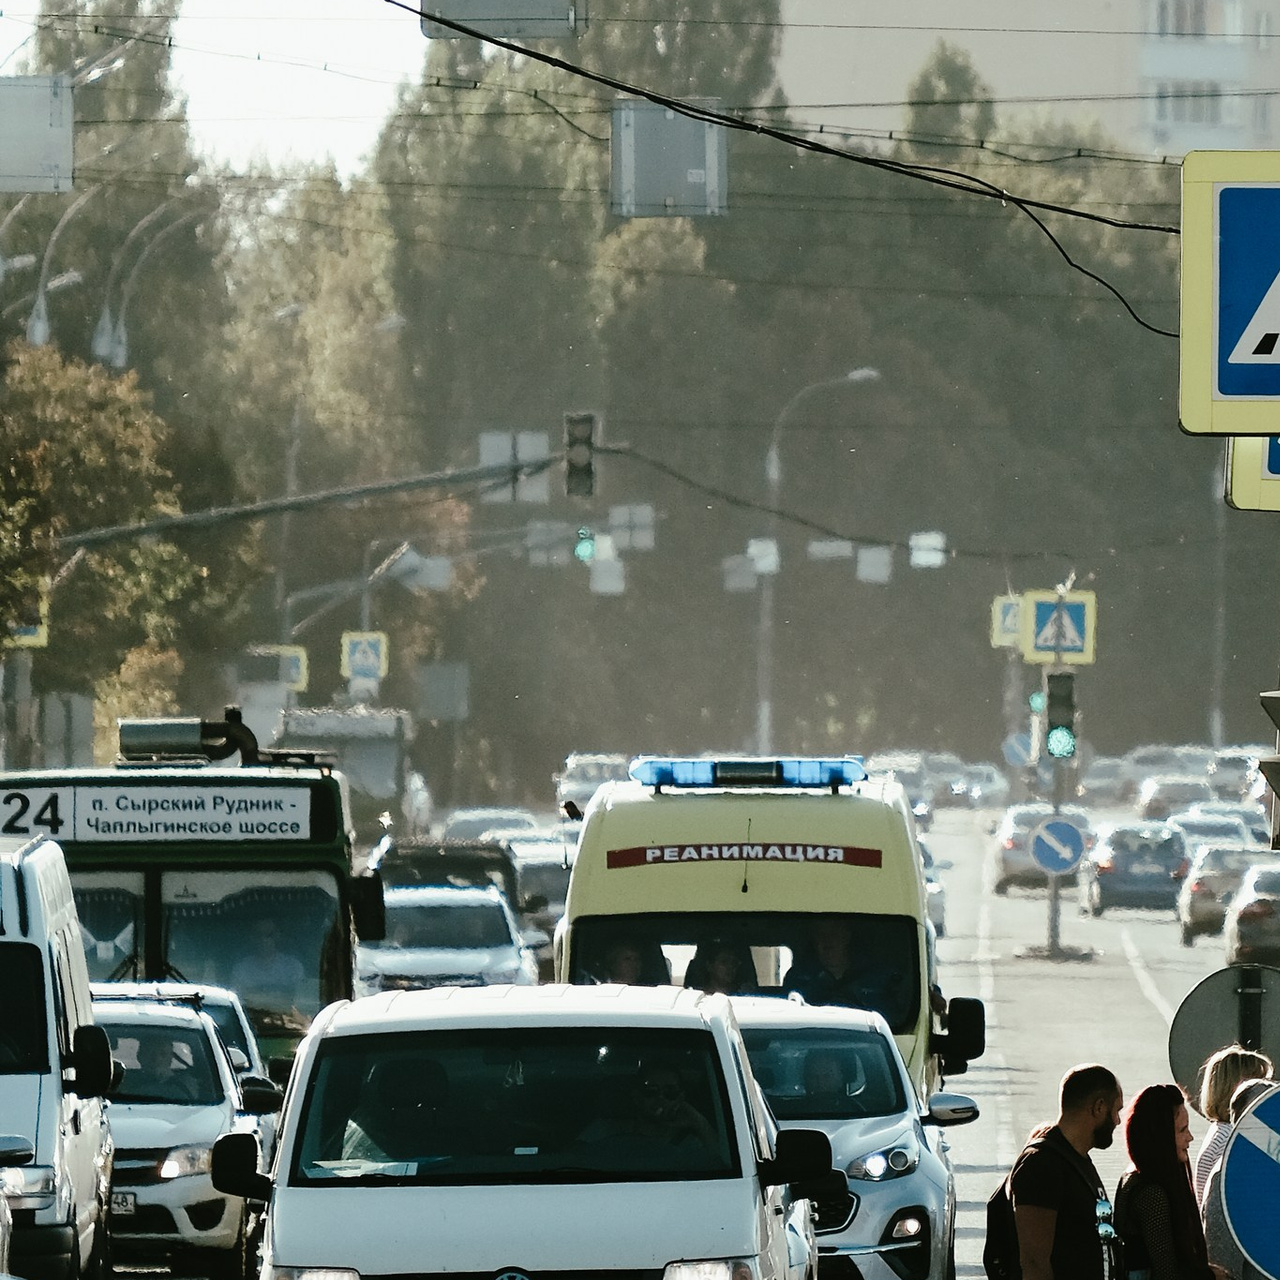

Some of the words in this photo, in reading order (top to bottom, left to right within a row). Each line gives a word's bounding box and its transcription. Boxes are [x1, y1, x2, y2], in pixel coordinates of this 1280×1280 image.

[2, 792, 64, 835] 24
[92, 798, 108, 811] п.
[115, 794, 205, 815] Сырский
[213, 795, 283, 815] Рудник
[87, 817, 232, 834] Чаплыгинское
[239, 821, 301, 835] шоссе
[645, 845, 845, 863] РЕАНИМАЦИЯ
